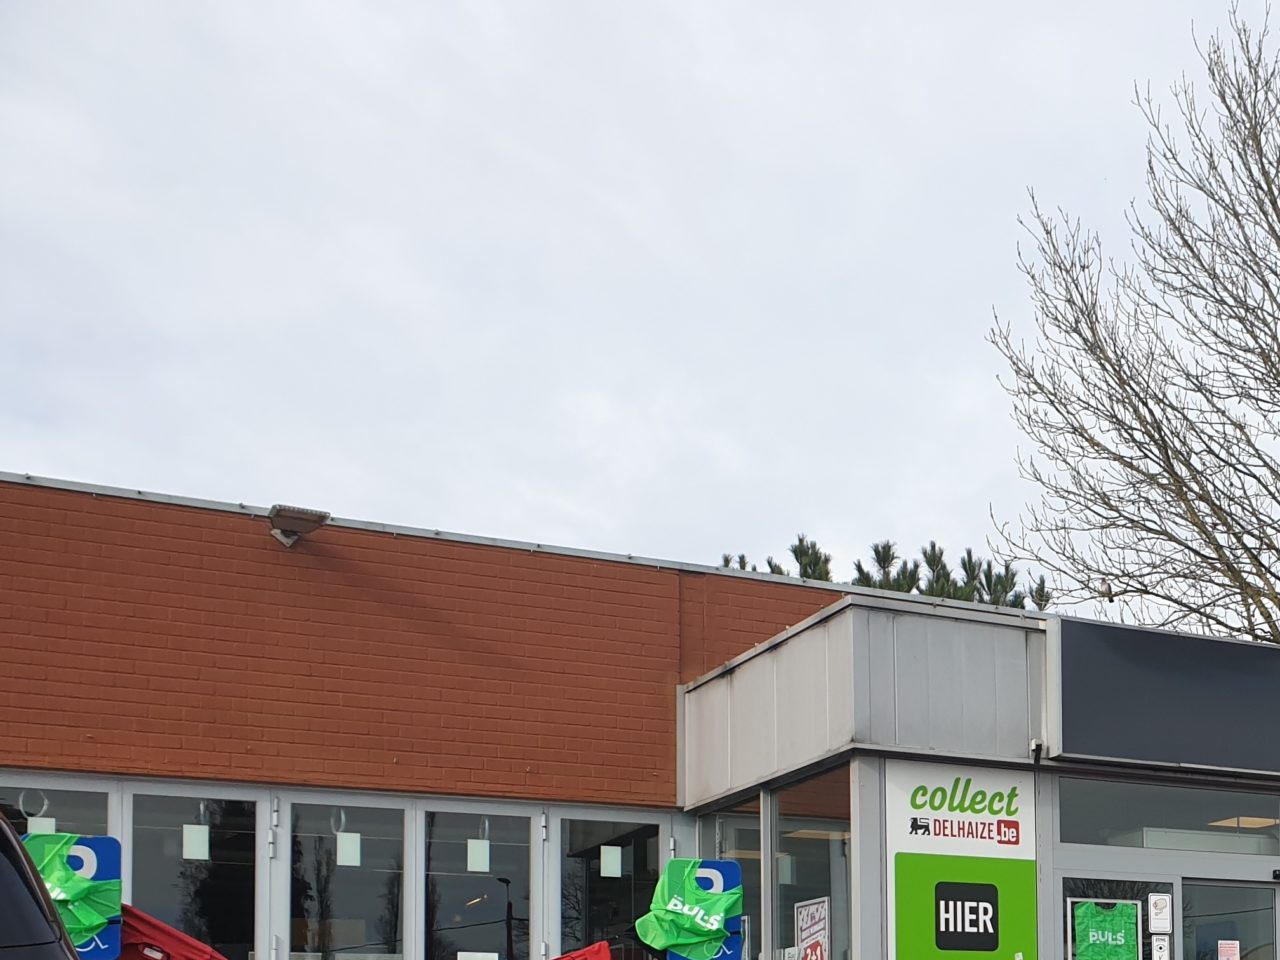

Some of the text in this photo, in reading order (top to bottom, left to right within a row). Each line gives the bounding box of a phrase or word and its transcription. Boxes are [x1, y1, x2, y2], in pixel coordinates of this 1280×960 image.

[910, 777, 1019, 816] collect
[933, 818, 995, 839] DELHAIZE
[939, 900, 994, 933] HIER
